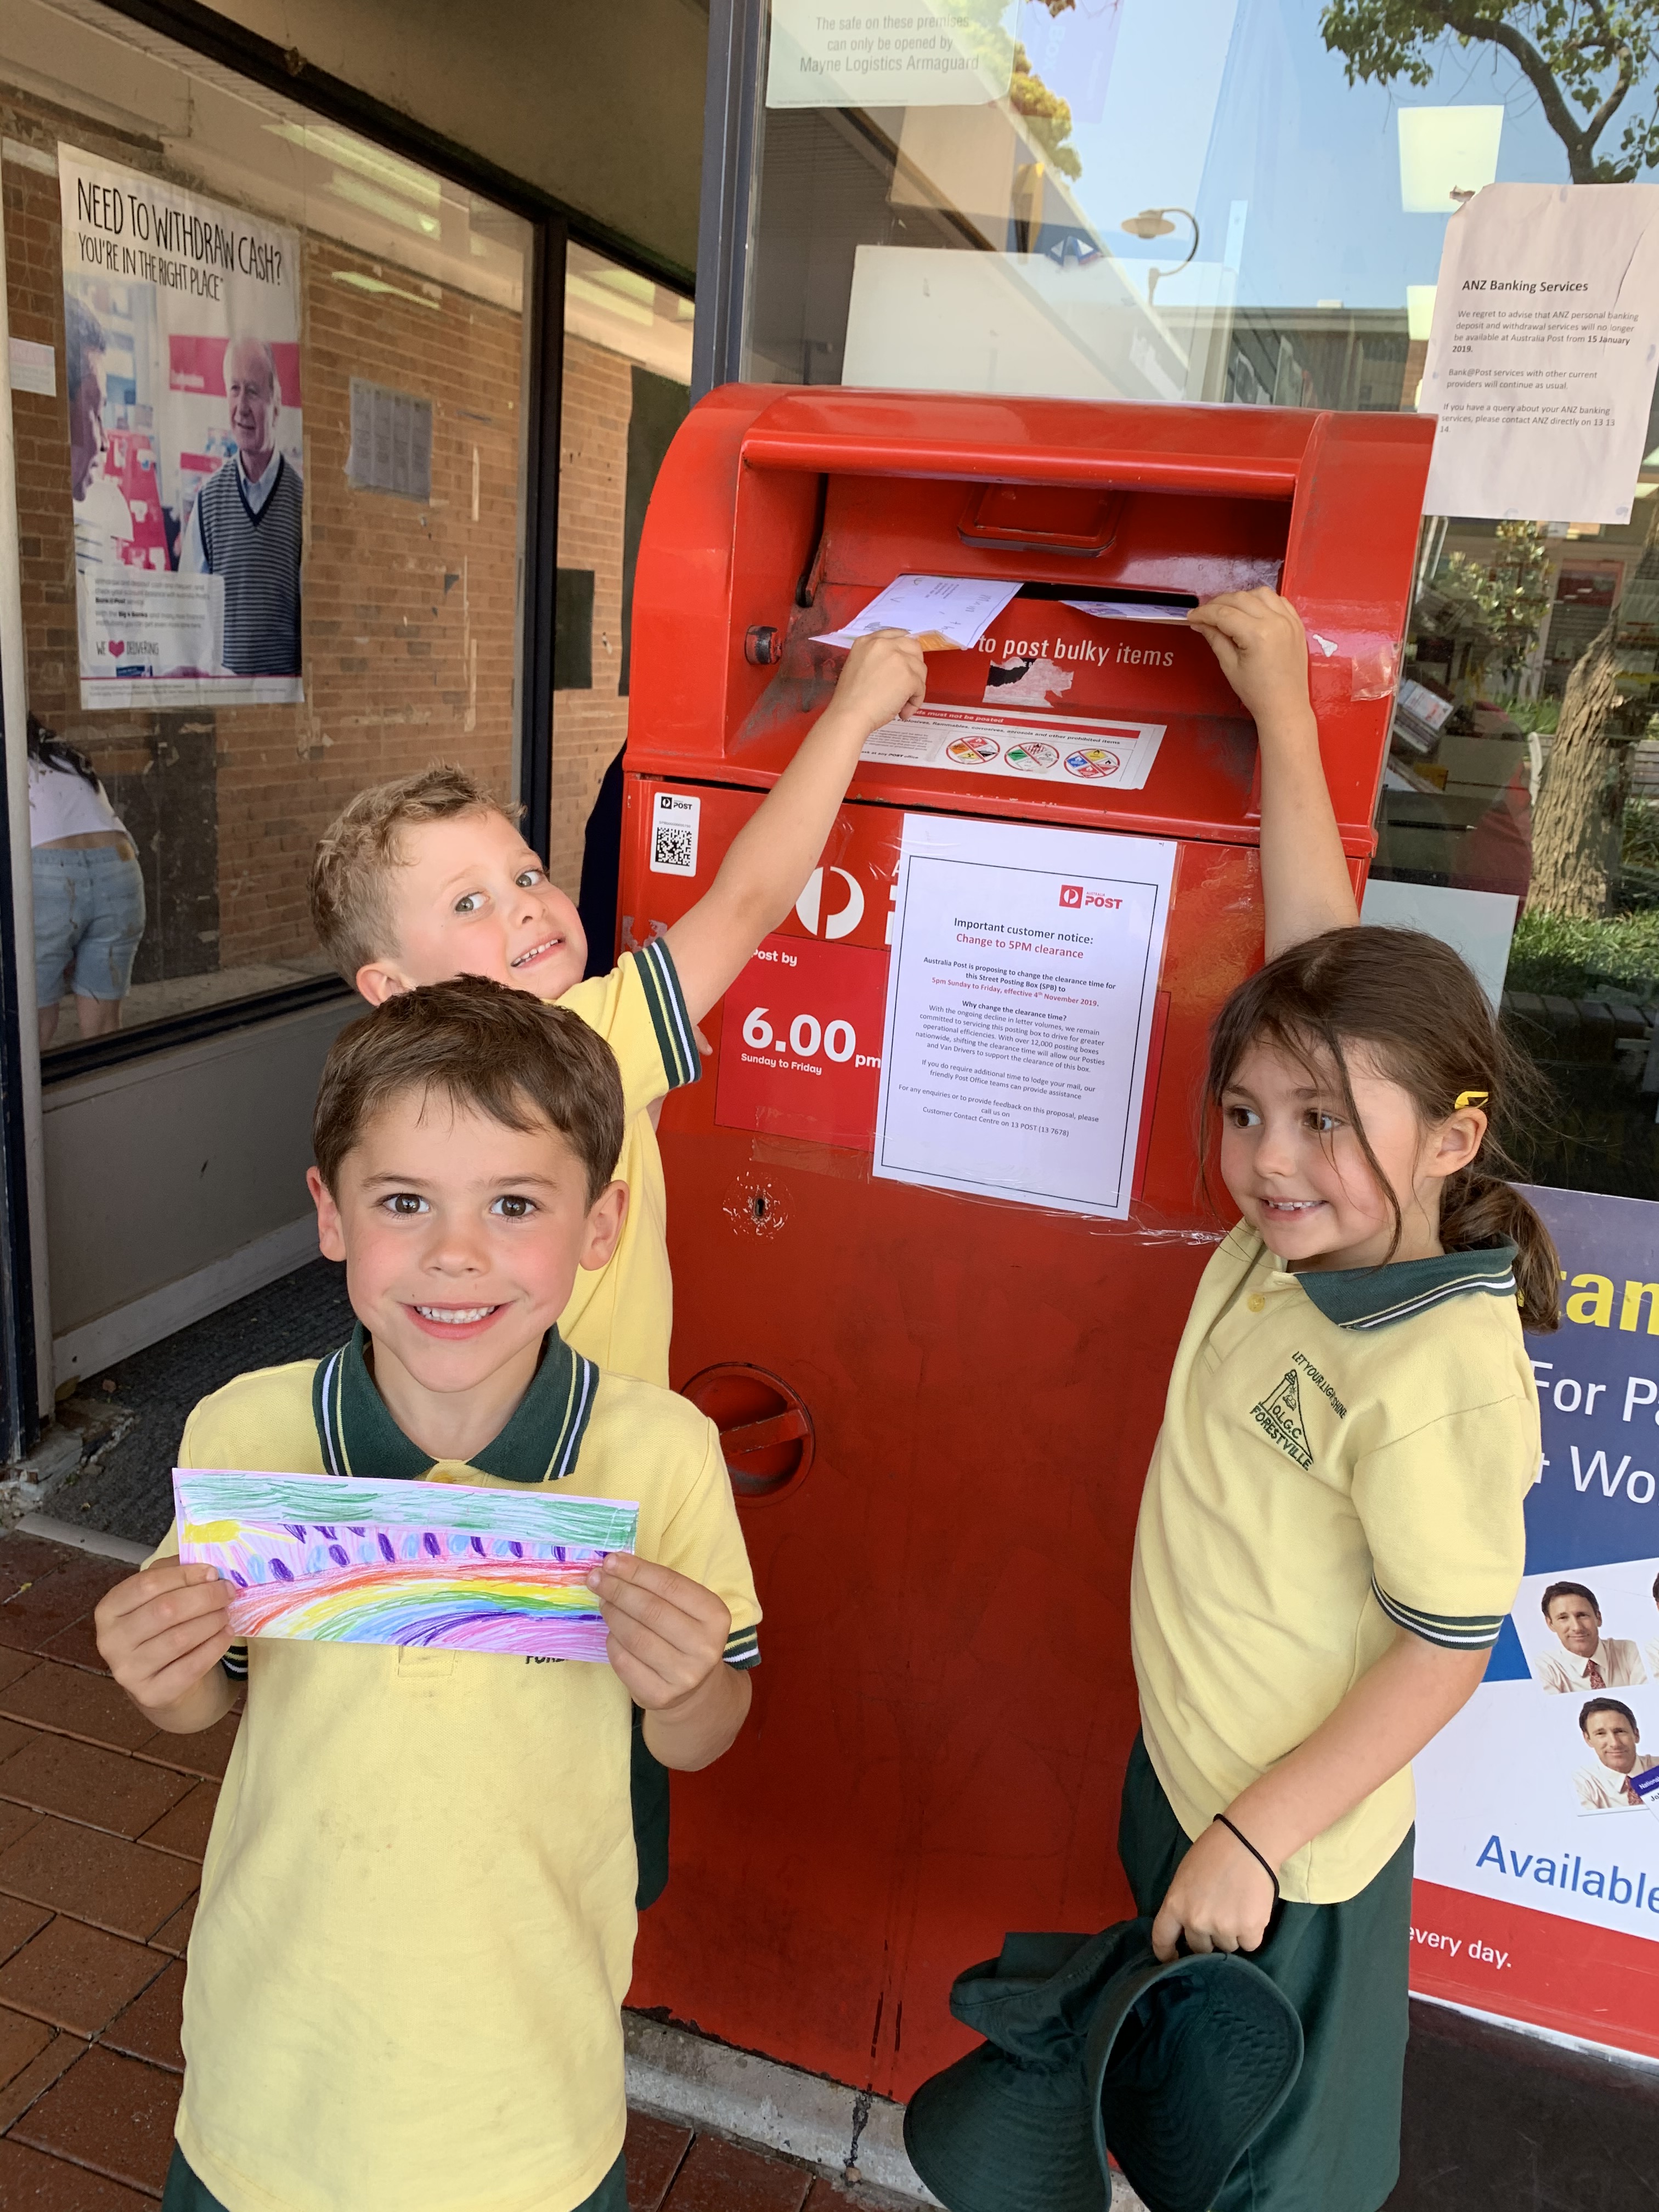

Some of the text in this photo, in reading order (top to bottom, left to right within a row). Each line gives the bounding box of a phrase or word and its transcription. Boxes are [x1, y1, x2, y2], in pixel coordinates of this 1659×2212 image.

[816, 14, 969, 30] The safe on these premises
[827, 35, 953, 53] can only be opened by
[800, 54, 979, 75] Mayne Logistics Armaguard
[78, 178, 281, 285] NEED TO WITHDRAW CASH?
[78, 233, 119, 272] YOU'RE
[123, 247, 136, 275] IN
[139, 250, 157, 283] THE
[159, 257, 187, 289] RIGHT
[1462, 279, 1588, 294] ANZ Banking Services
[1455, 321, 1483, 330] deposit
[1503, 322, 1545, 330] withdrawal
[1610, 324, 1634, 334] longer
[1508, 310, 1532, 318] advise
[1571, 311, 1606, 319] personal
[1607, 311, 1639, 321] banking
[1510, 334, 1544, 342] Australia
[1566, 334, 1585, 342] from
[1599, 335, 1630, 346] January
[1448, 368, 1492, 376] Bank@Post
[1545, 369, 1567, 377] other
[978, 635, 1173, 666] to post bulky items
[1085, 896, 1122, 909] POST
[954, 917, 1093, 944] Important customer notice:
[956, 933, 1083, 958] Change to 5PM clearance
[781, 952, 797, 967] by
[923, 957, 951, 966] Australia
[975, 966, 1007, 975] proposing
[1017, 970, 1040, 979] change
[1054, 975, 1087, 985] clearance
[947, 979, 970, 989] Sunday
[980, 984, 1002, 994] Friday,
[1003, 988, 1032, 997] effective
[1044, 993, 1079, 1003] November
[1080, 998, 1099, 1007] 2019.
[979, 974, 998, 983] Street
[1000, 977, 1024, 988] Posting
[1039, 983, 1057, 992] (SPB)
[962, 1000, 977, 1009] Why
[978, 1003, 1001, 1012] change
[1014, 1008, 1046, 1018] clearance
[743, 1007, 881, 1068] 6.00 pm
[741, 1053, 822, 1075] Sunday to Friday
[922, 1106, 952, 1116] Customer
[953, 1111, 977, 1121] Contact
[978, 1116, 1000, 1125] Centre
[1051, 1127, 1069, 1137] 7678)
[1292, 1351, 1307, 1365] LET
[1303, 1362, 1324, 1386] YOUR
[1331, 1397, 1347, 1419] SHINE
[1623, 1376, 1659, 1426] P
[1249, 1406, 1312, 1471] FORESTVILLE
[1571, 1446, 1659, 1505] Wo
[1476, 1835, 1659, 1914] Available
[1469, 1940, 1511, 1970] day.
